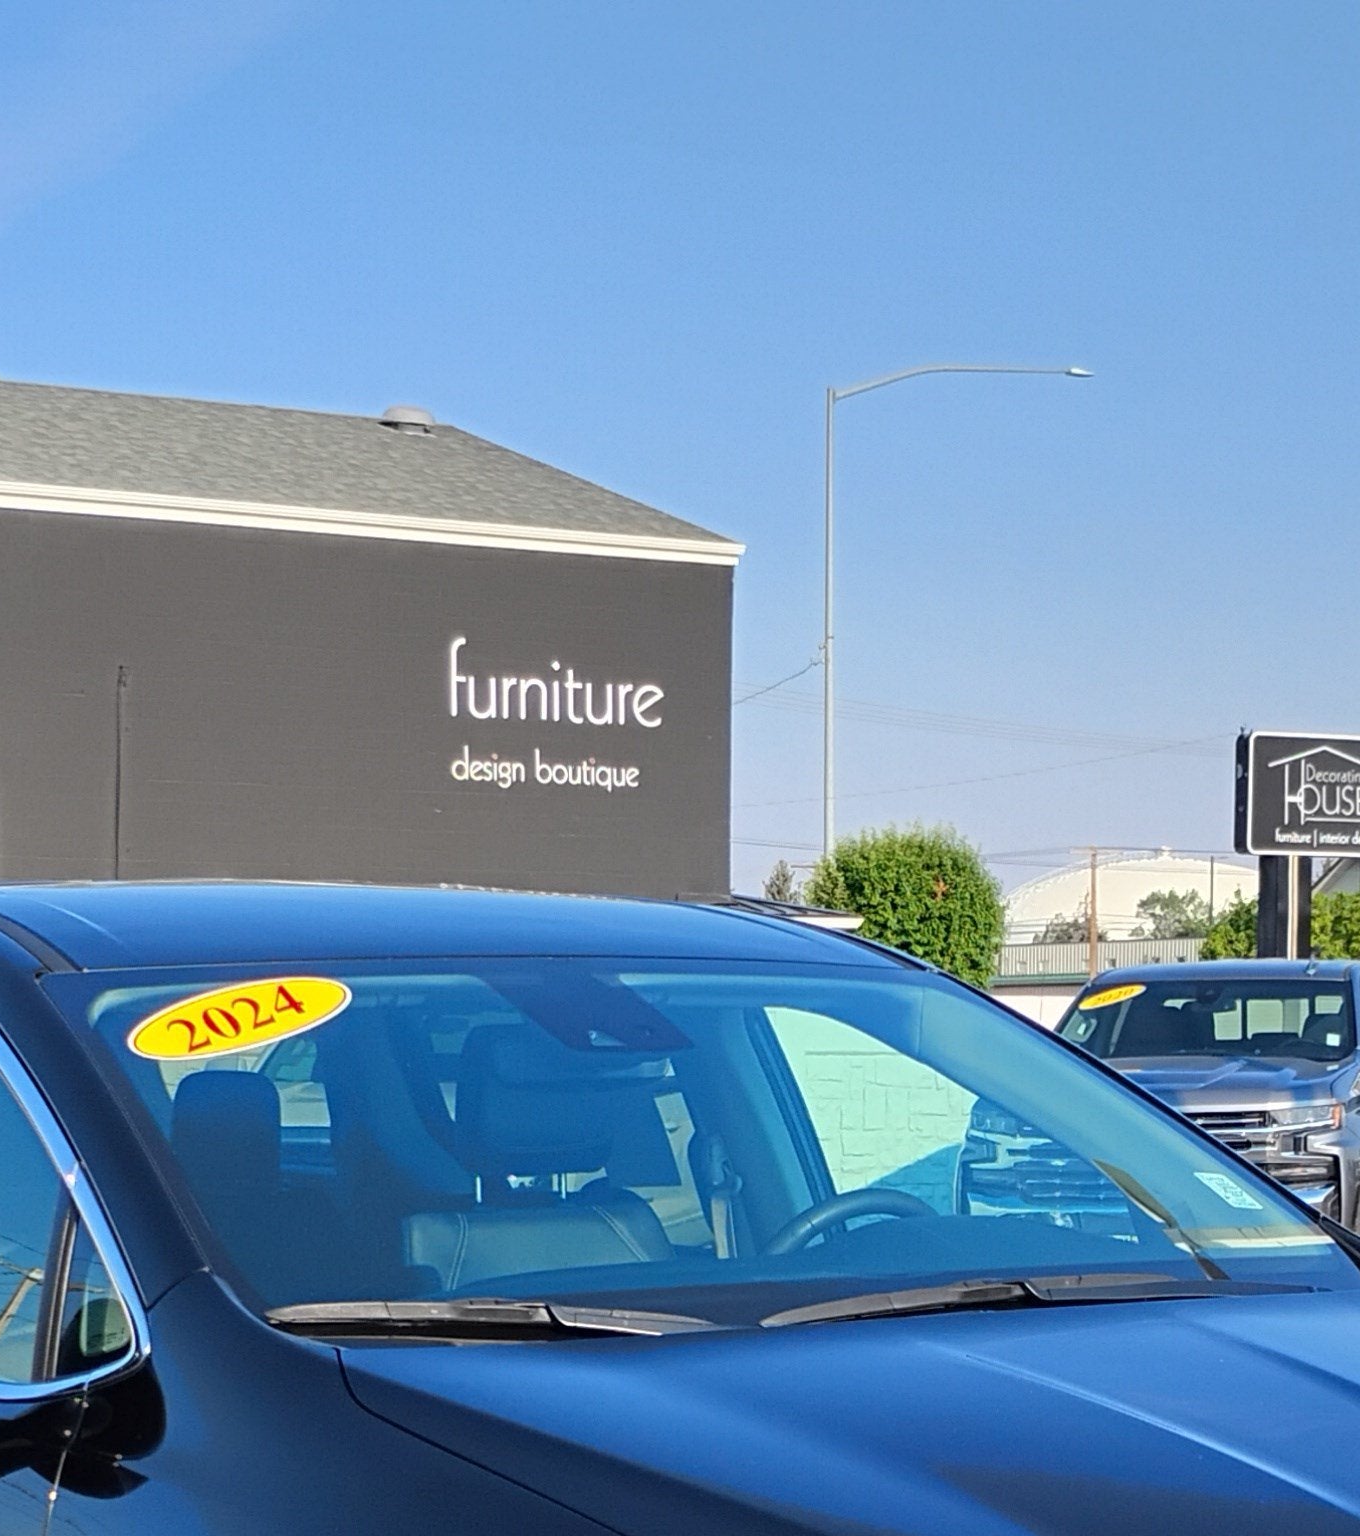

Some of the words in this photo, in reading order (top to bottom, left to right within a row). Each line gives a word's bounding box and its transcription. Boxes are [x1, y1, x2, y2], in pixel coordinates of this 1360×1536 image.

[450, 636, 665, 728] furniture
[451, 745, 526, 789] design
[534, 748, 640, 793] boutique
[1274, 827, 1312, 844] furniture
[1319, 829, 1351, 845] interior
[166, 984, 306, 1053] 2024
